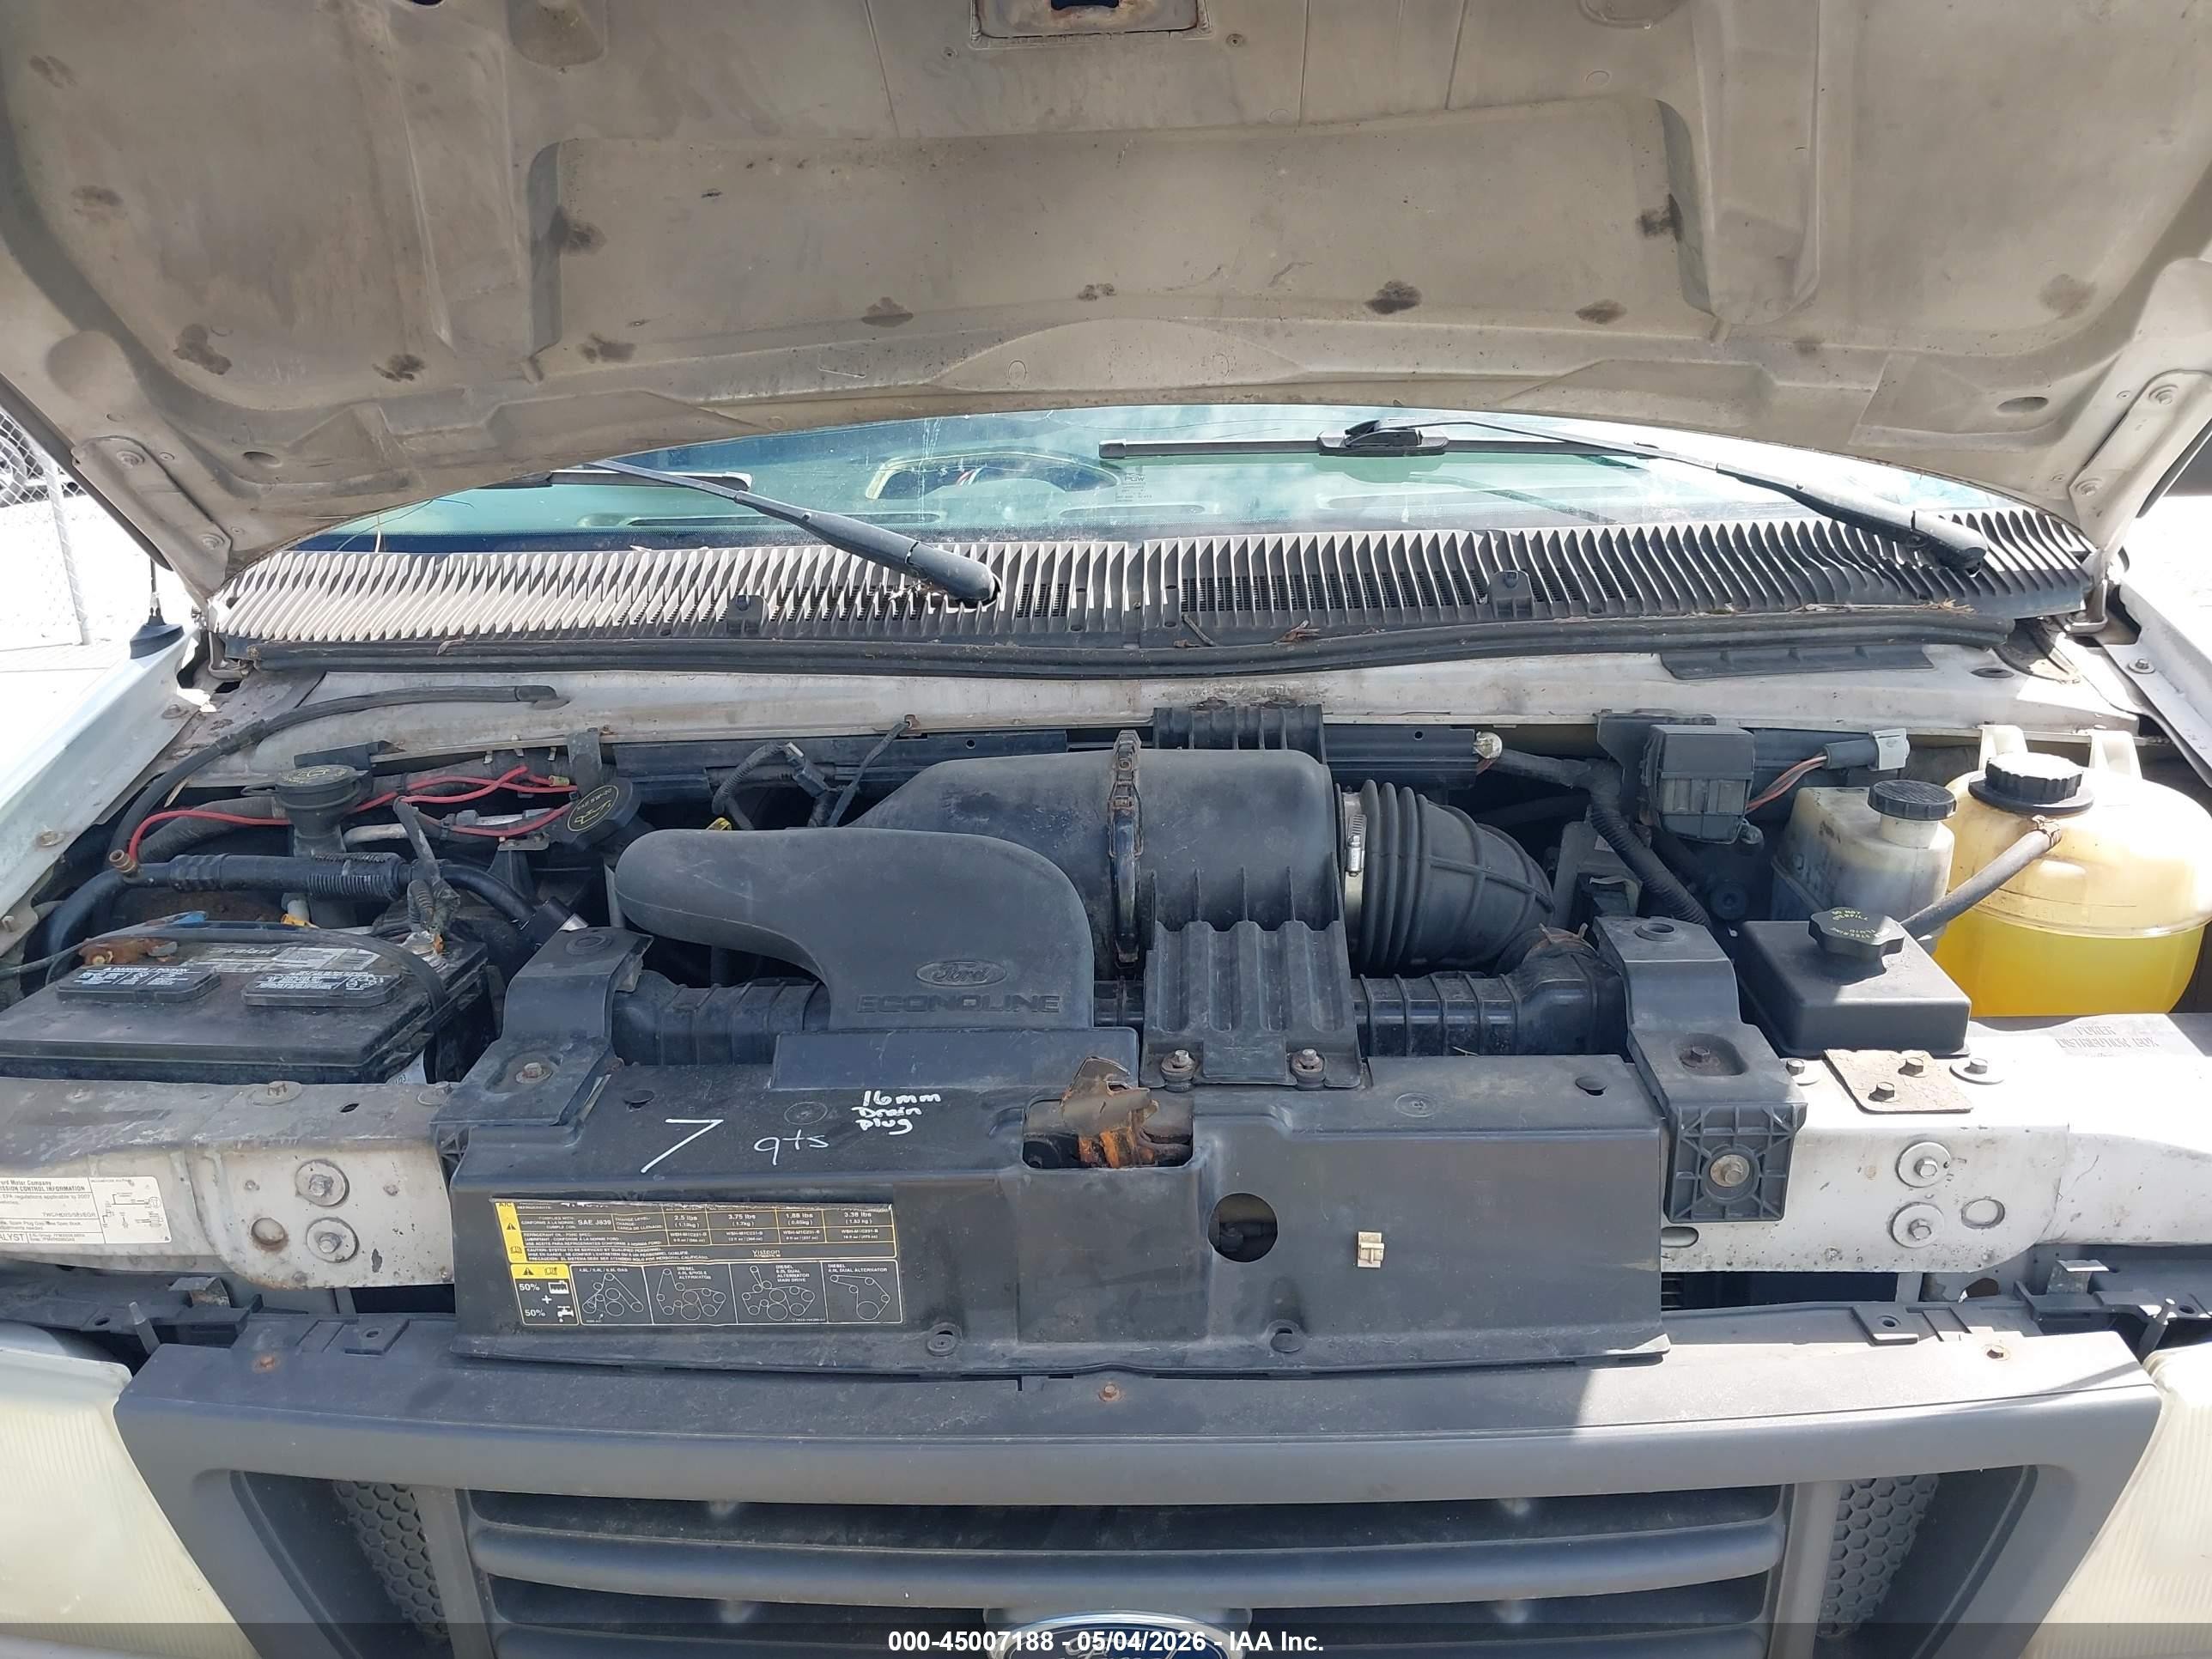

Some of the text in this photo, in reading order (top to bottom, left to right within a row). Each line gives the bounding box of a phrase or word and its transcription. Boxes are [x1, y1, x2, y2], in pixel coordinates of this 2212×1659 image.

[932, 959, 989, 982] Ford
[856, 994, 1061, 1013] ECONOLINE
[641, 1119, 725, 1174] 7
